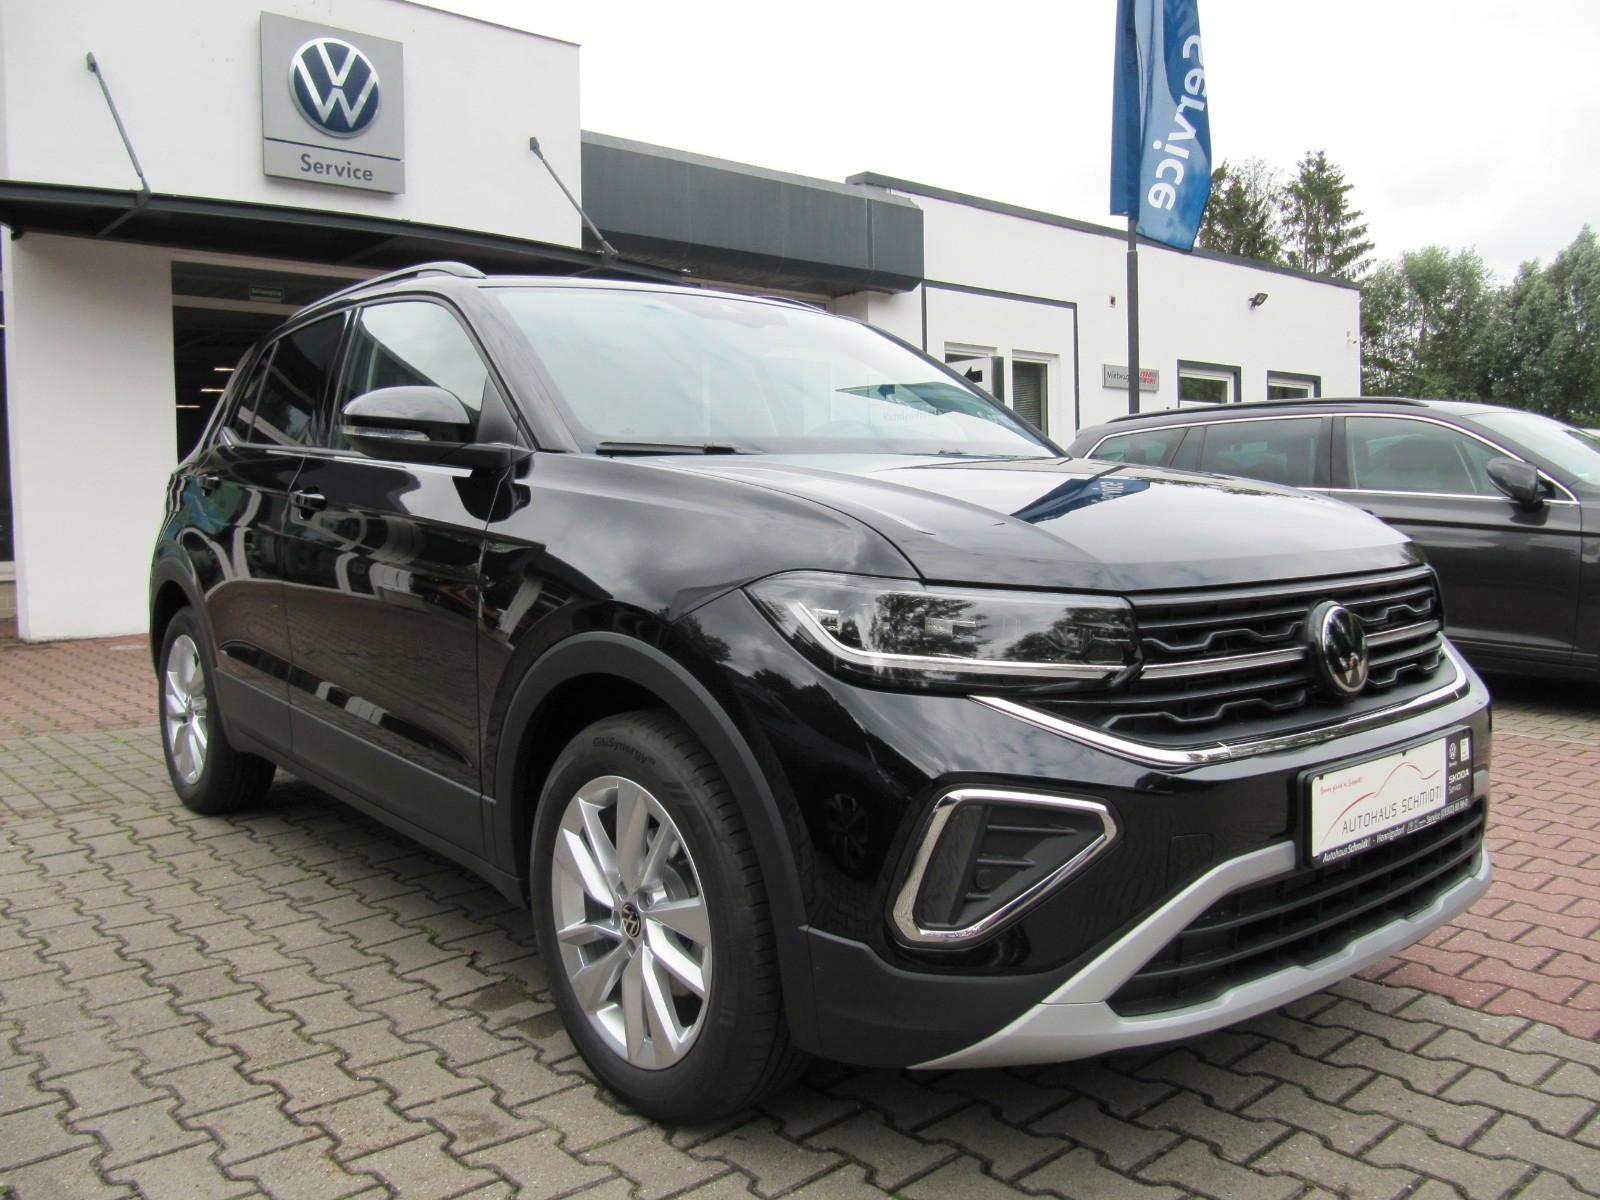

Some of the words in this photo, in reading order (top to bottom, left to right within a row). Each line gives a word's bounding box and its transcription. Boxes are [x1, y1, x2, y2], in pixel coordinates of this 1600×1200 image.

[300, 153, 374, 182] Service
[1342, 803, 1398, 835] AUTOHAUS
[1402, 786, 1441, 814] SCHMIDT
[1322, 845, 1348, 863] Autohaus
